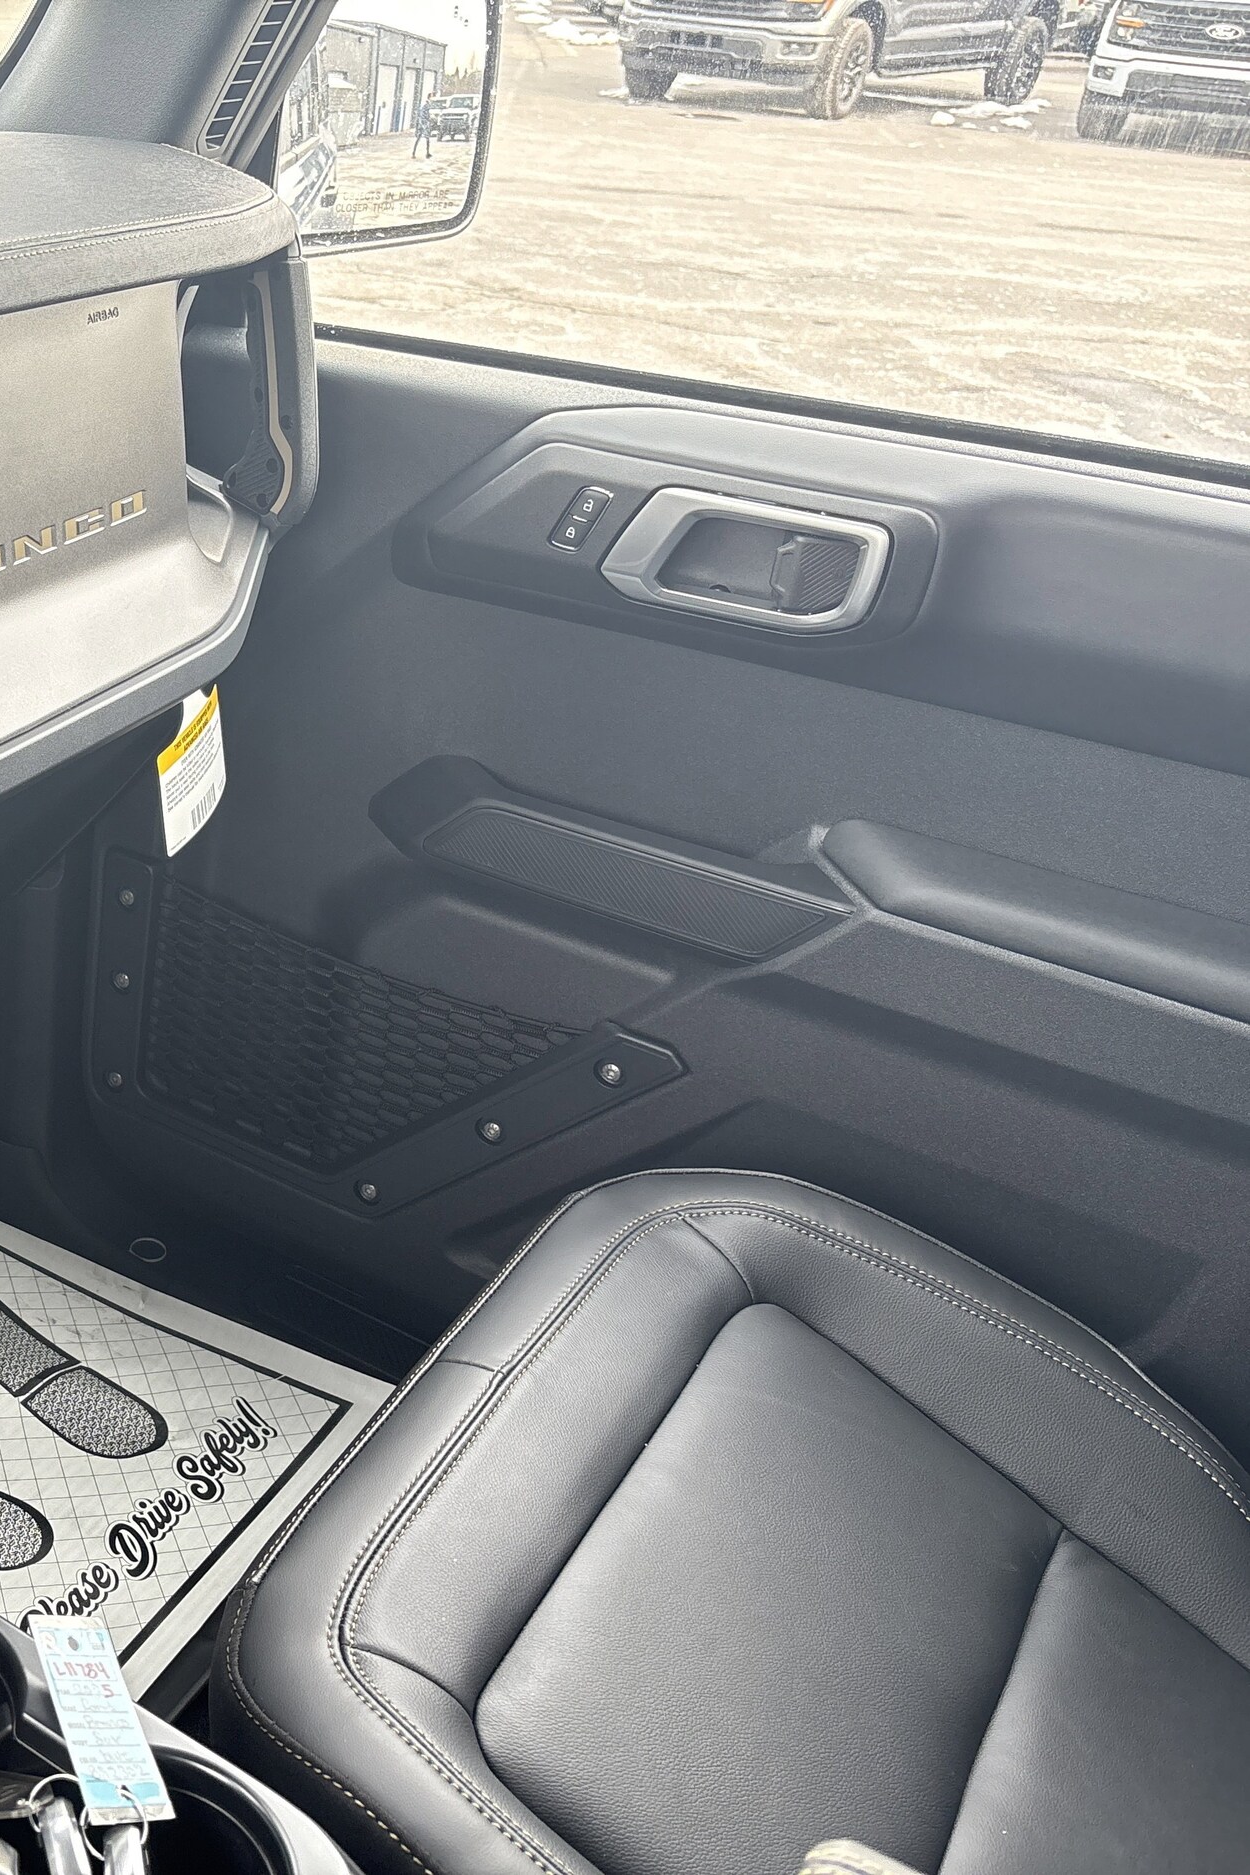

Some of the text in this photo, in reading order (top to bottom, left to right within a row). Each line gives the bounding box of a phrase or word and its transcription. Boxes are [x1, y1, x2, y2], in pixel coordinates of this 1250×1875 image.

[399, 190, 430, 201] MIRROR
[433, 189, 450, 200] ARE
[335, 203, 368, 213] CLOSER
[372, 202, 395, 213] THAN
[399, 202, 419, 212] THEY
[86, 306, 120, 326] AIRBAG
[106, 1487, 190, 1580] Drive
[174, 1397, 276, 1502] Safely!
